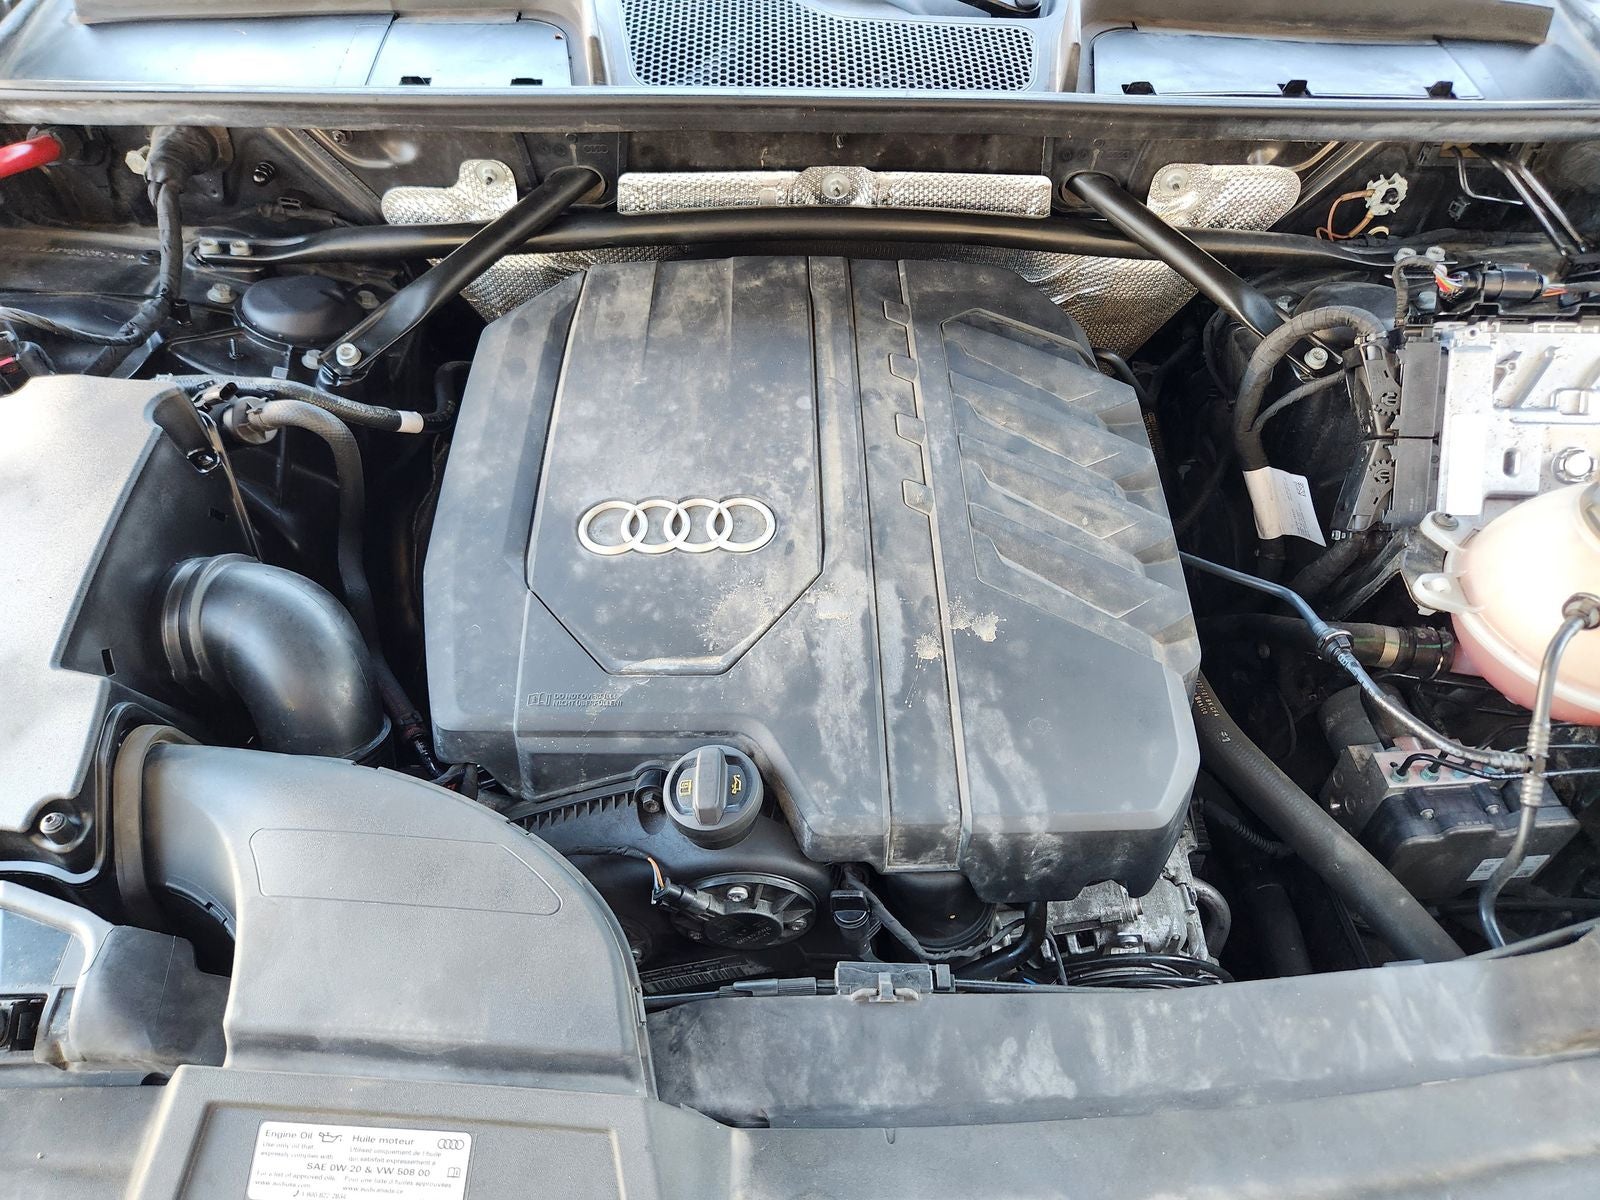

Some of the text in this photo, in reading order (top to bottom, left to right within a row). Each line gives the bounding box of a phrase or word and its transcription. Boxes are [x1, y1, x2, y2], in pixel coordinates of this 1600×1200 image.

[1195, 695, 1208, 715] Mexico
[265, 1129, 313, 1140] Engine Oil
[352, 1134, 415, 1146] Huile moteur
[306, 1162, 327, 1171] SAE
[364, 1166, 372, 1174] &
[376, 1166, 395, 1175] VW
[397, 1168, 415, 1176] 508
[418, 1169, 431, 1177] 00
